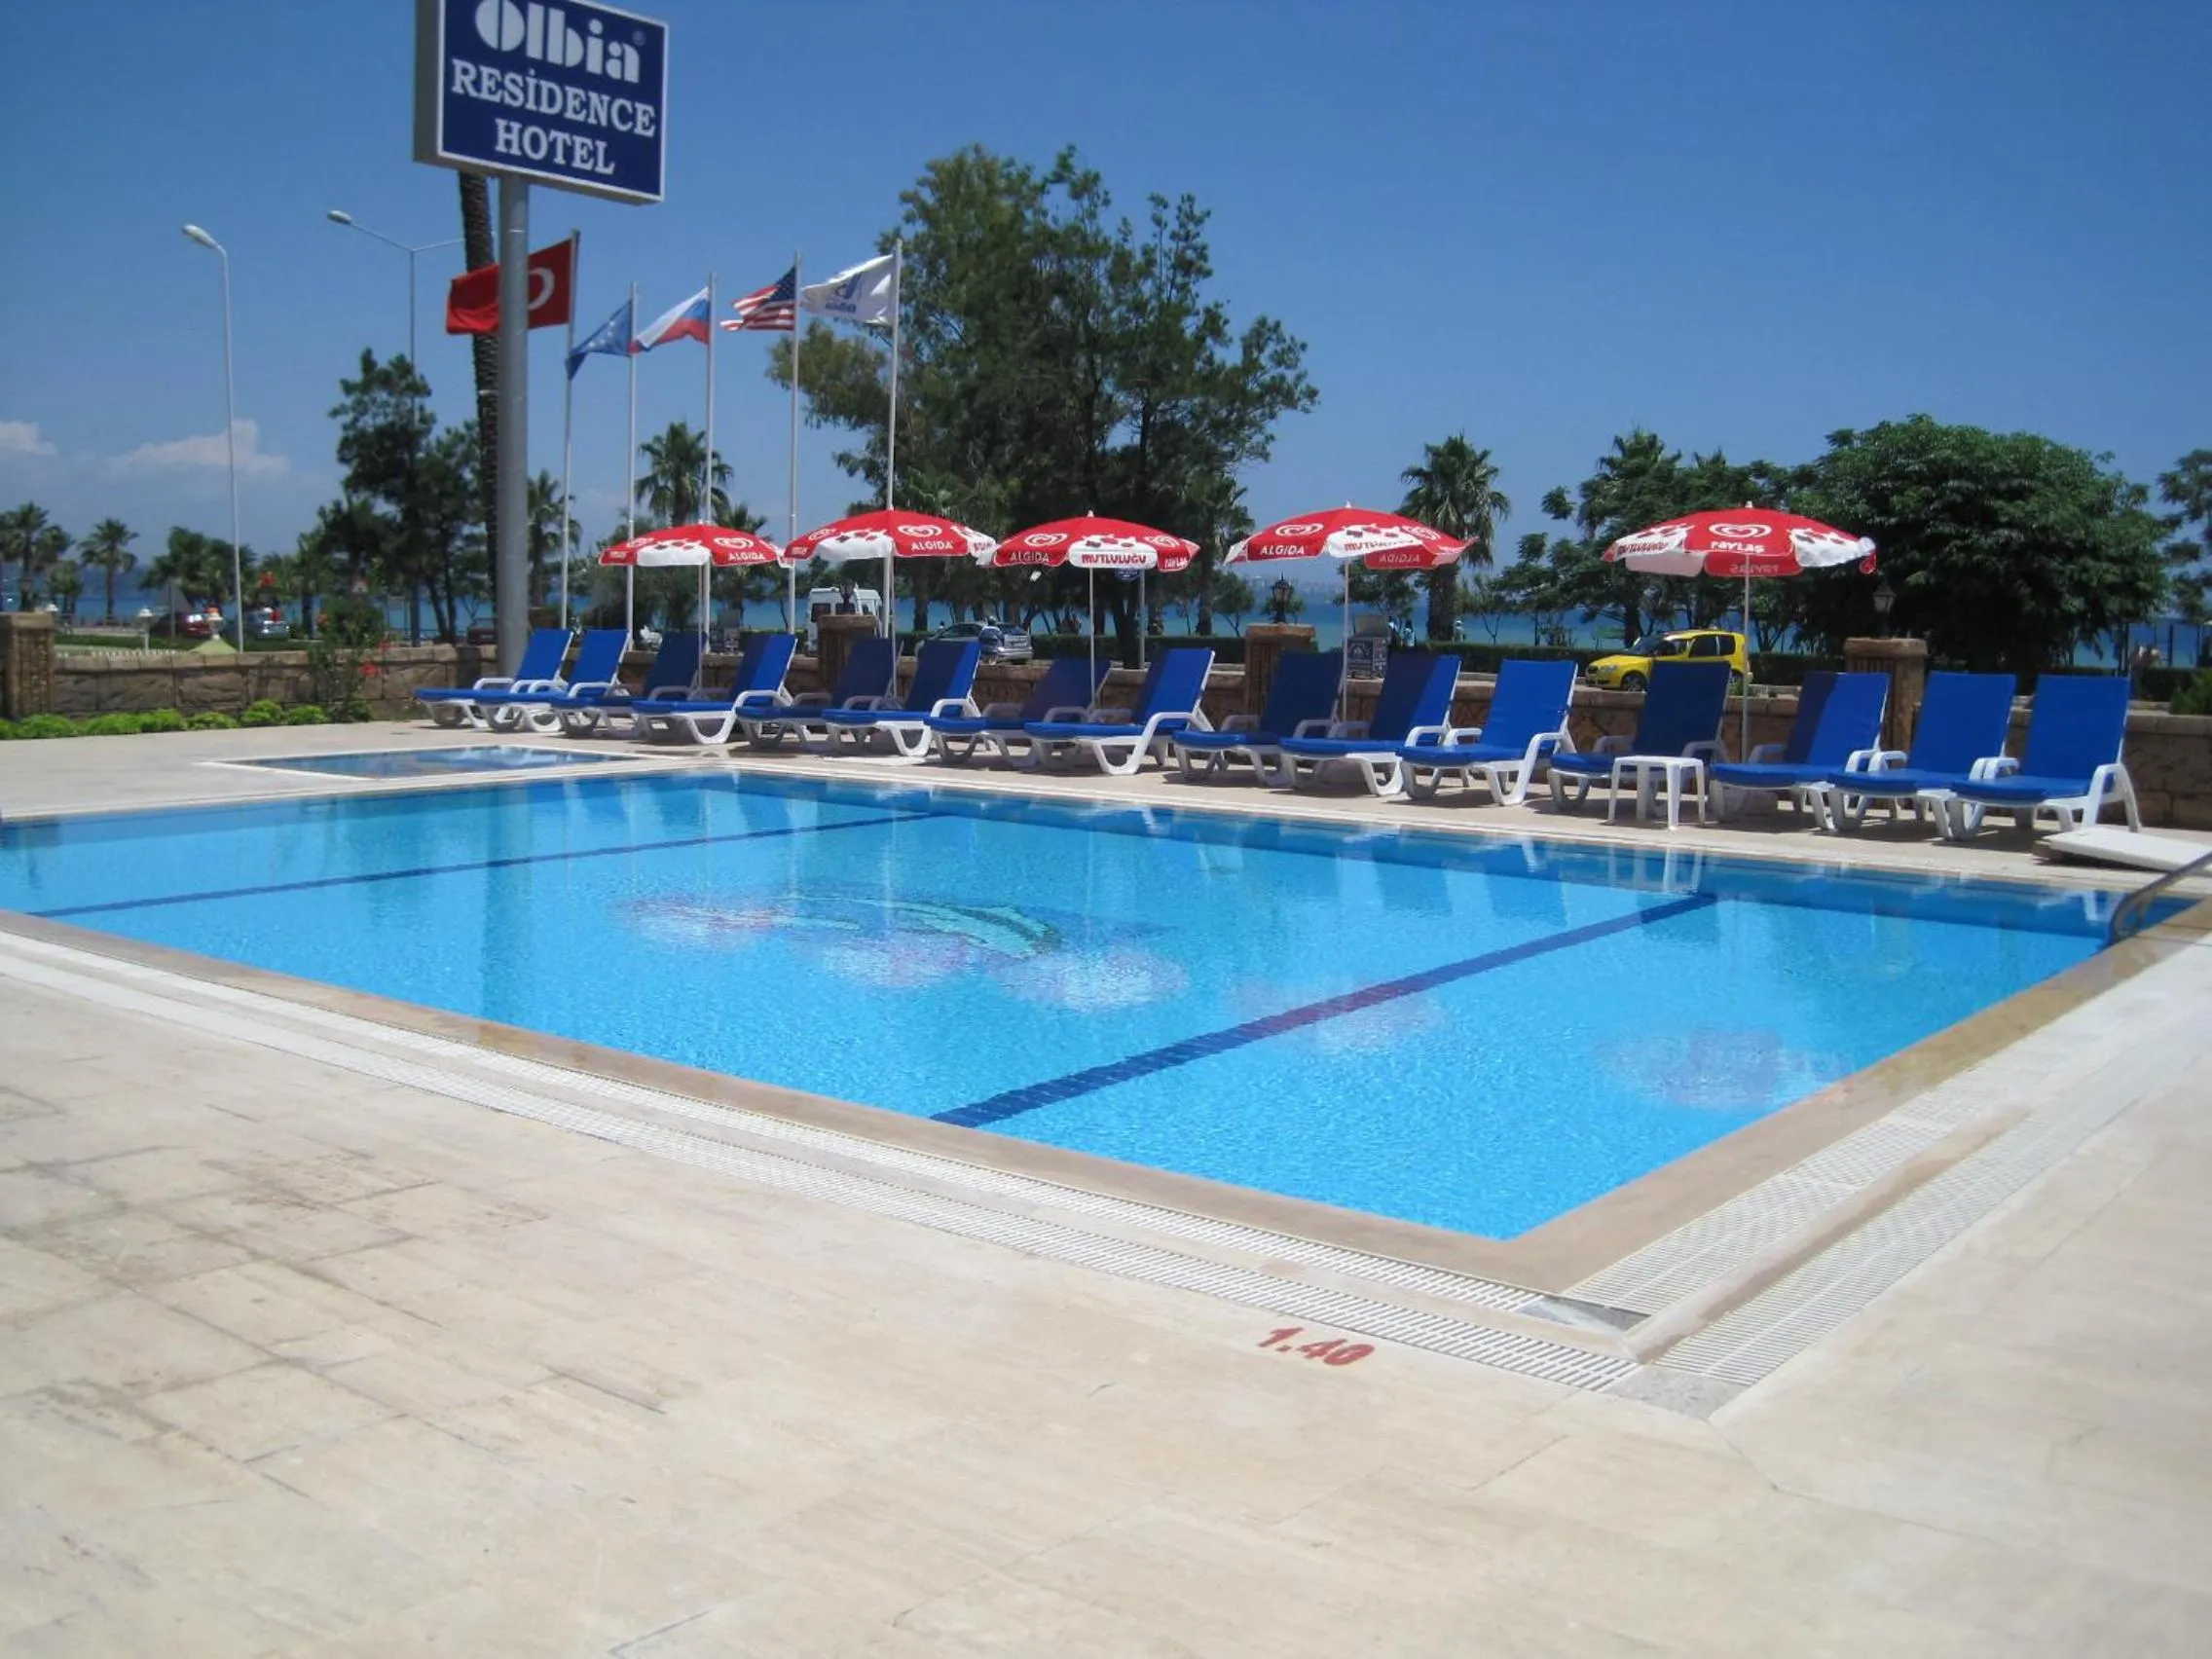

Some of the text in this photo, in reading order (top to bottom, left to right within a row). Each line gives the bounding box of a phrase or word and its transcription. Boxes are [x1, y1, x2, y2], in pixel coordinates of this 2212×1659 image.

[475, 0, 640, 83] Olbia
[495, 118, 615, 174] HOTEL
[911, 541, 953, 551] ALGIDA
[1261, 545, 1305, 555] ALGIDA
[729, 552, 764, 561] ALGIDA
[1010, 551, 1050, 563] ALGIDA
[1257, 1327, 1376, 1366] 1.40
